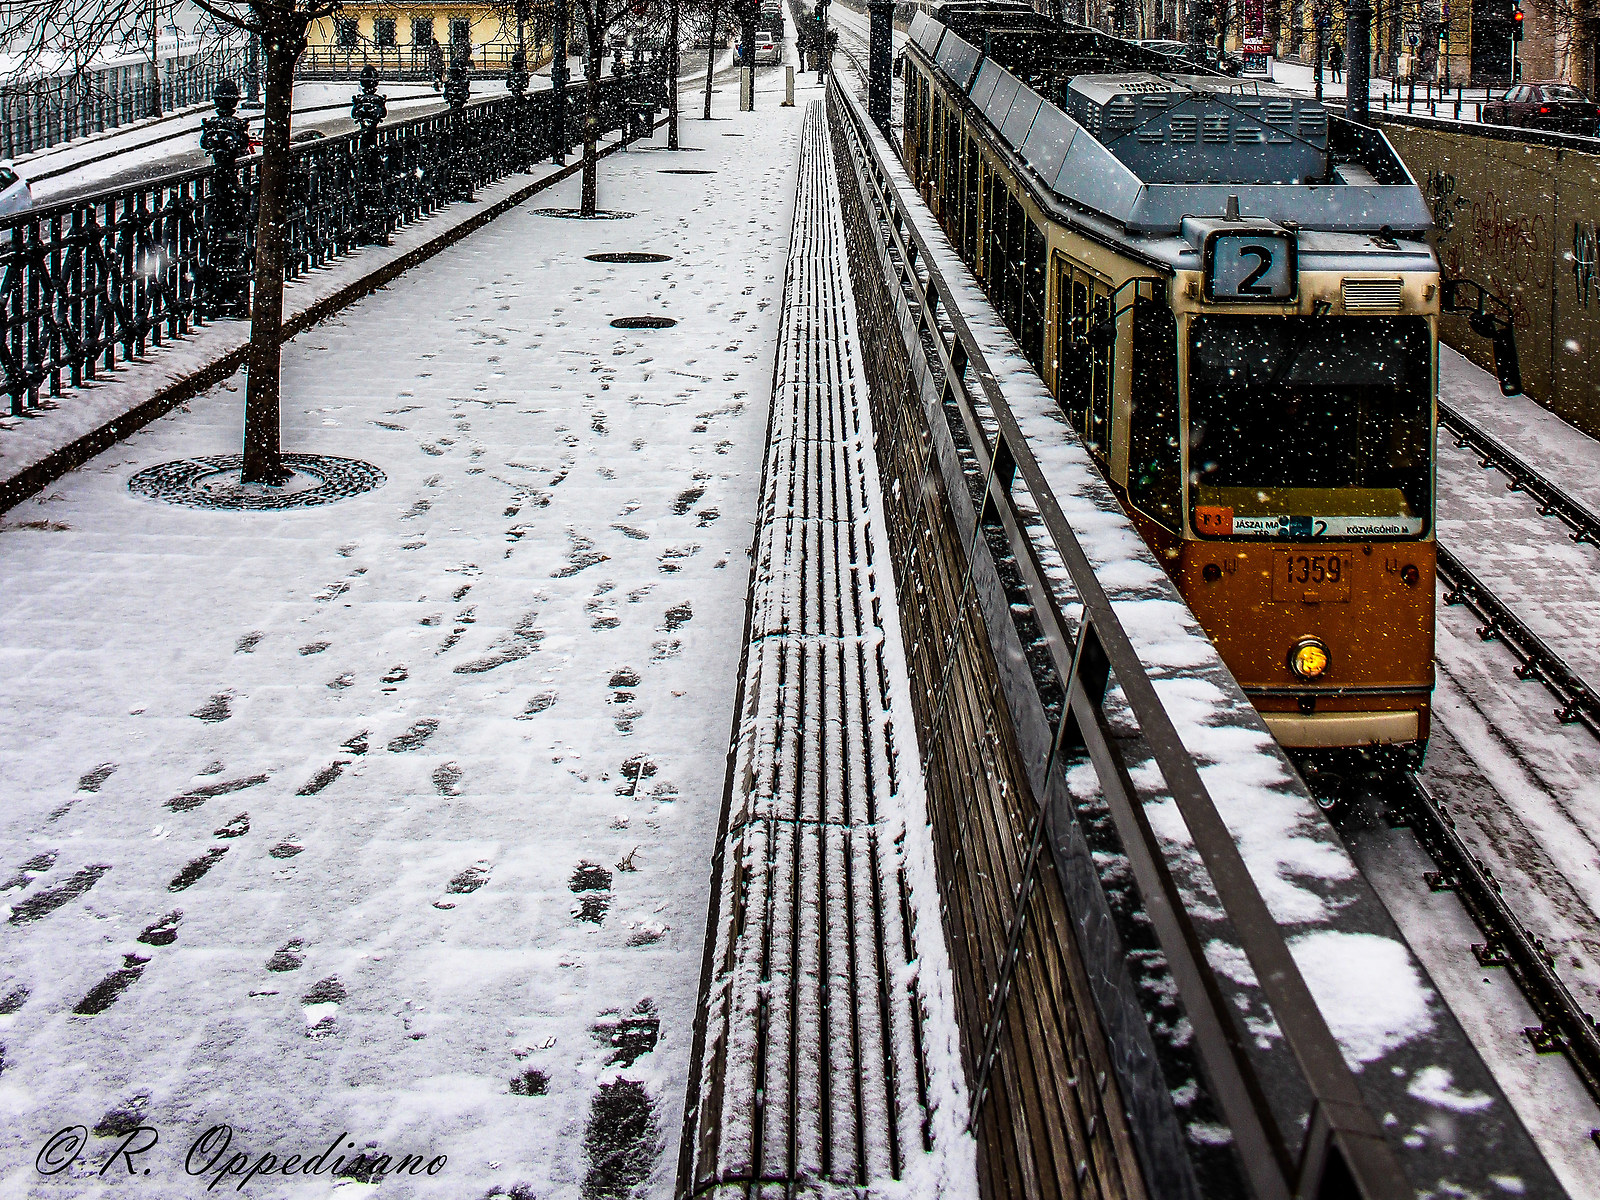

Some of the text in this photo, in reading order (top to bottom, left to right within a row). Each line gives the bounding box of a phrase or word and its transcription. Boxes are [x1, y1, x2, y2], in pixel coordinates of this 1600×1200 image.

[1237, 245, 1273, 294] 2
[1235, 519, 1280, 529] JÁSZAI MA
[1314, 520, 1328, 537] 2
[1346, 524, 1400, 534] KÖZVÁGÓHÍD
[1287, 555, 1341, 584] 1359
